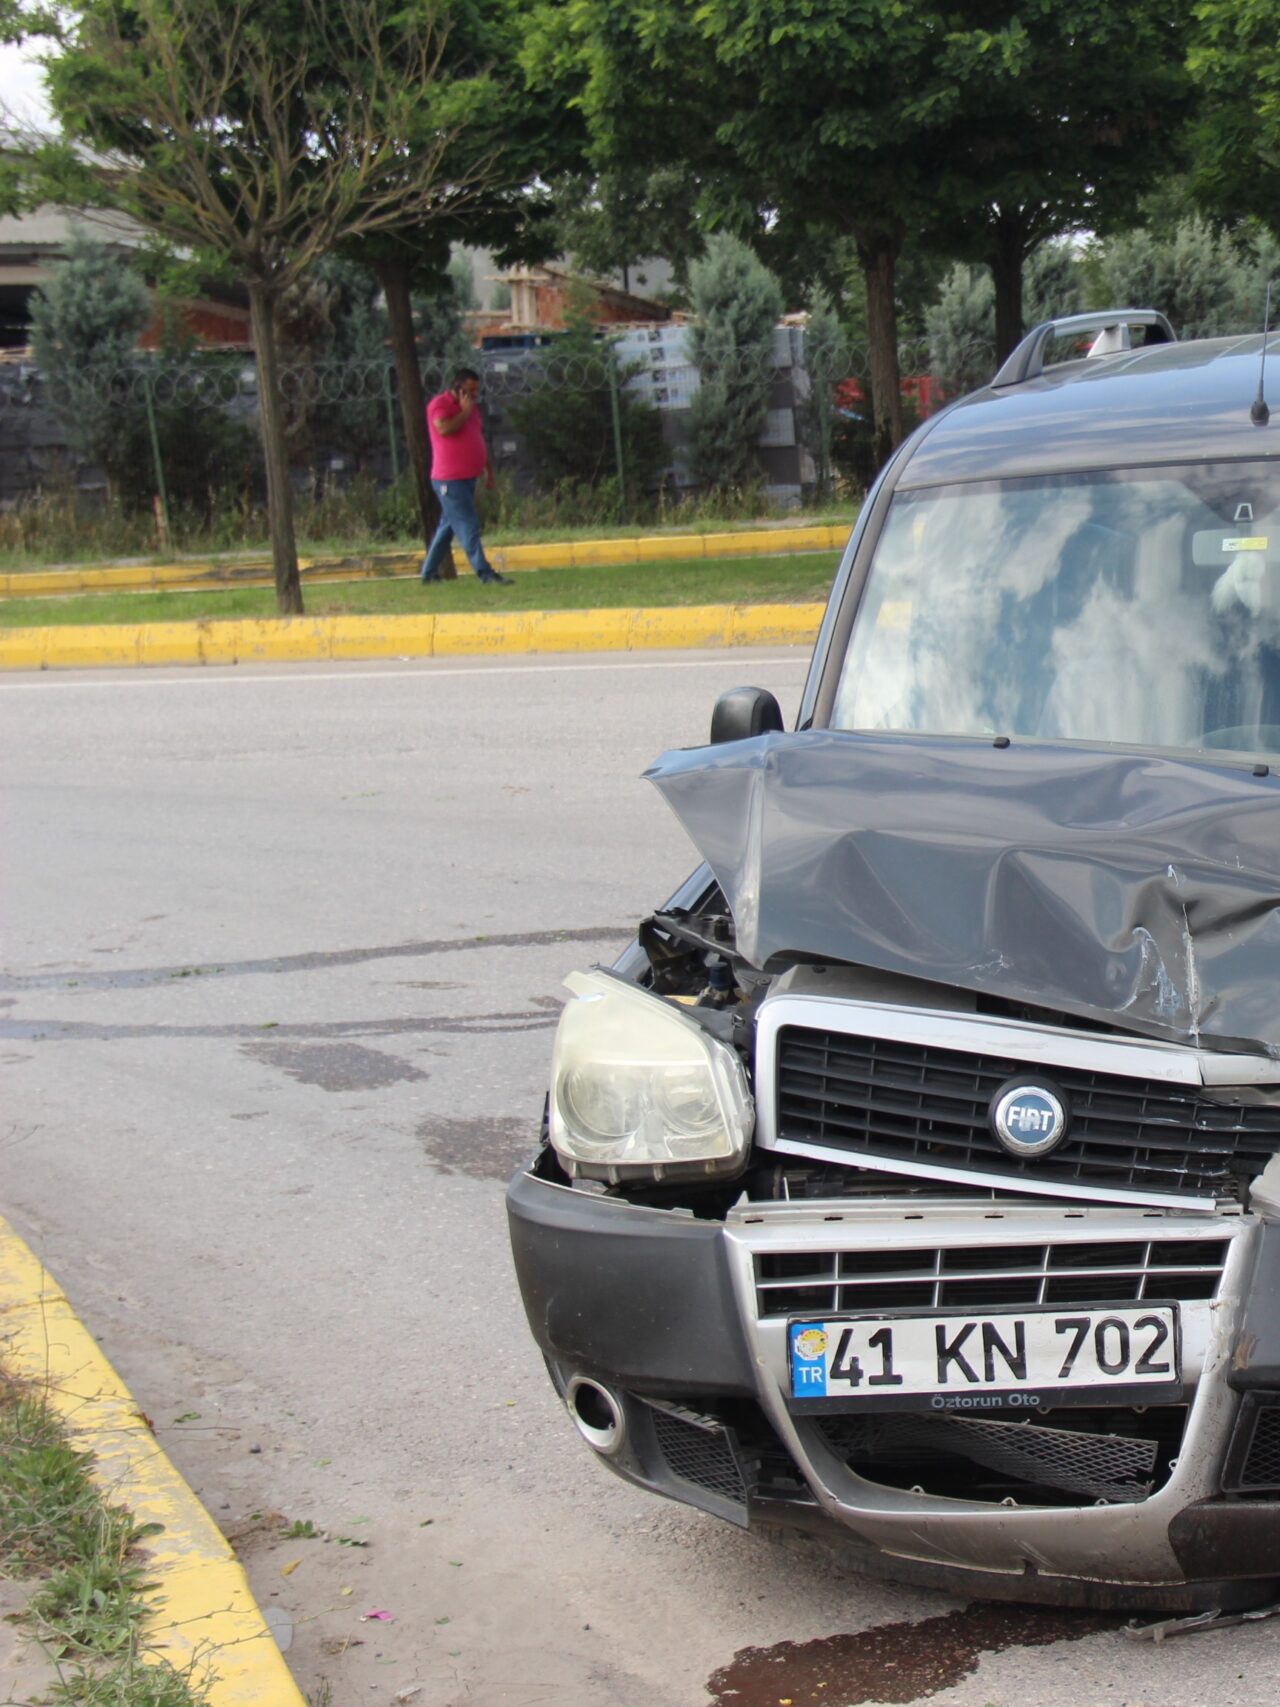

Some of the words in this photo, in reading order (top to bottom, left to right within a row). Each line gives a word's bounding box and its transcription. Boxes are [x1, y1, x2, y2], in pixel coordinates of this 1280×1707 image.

[1007, 1105, 1053, 1131] FIAT
[829, 1327, 903, 1387] 41
[935, 1320, 1027, 1384] KN
[1055, 1315, 1170, 1379] 702
[798, 1366, 823, 1384] TR
[931, 1393, 1002, 1409] Öztorun
[1008, 1393, 1040, 1407] Oto
